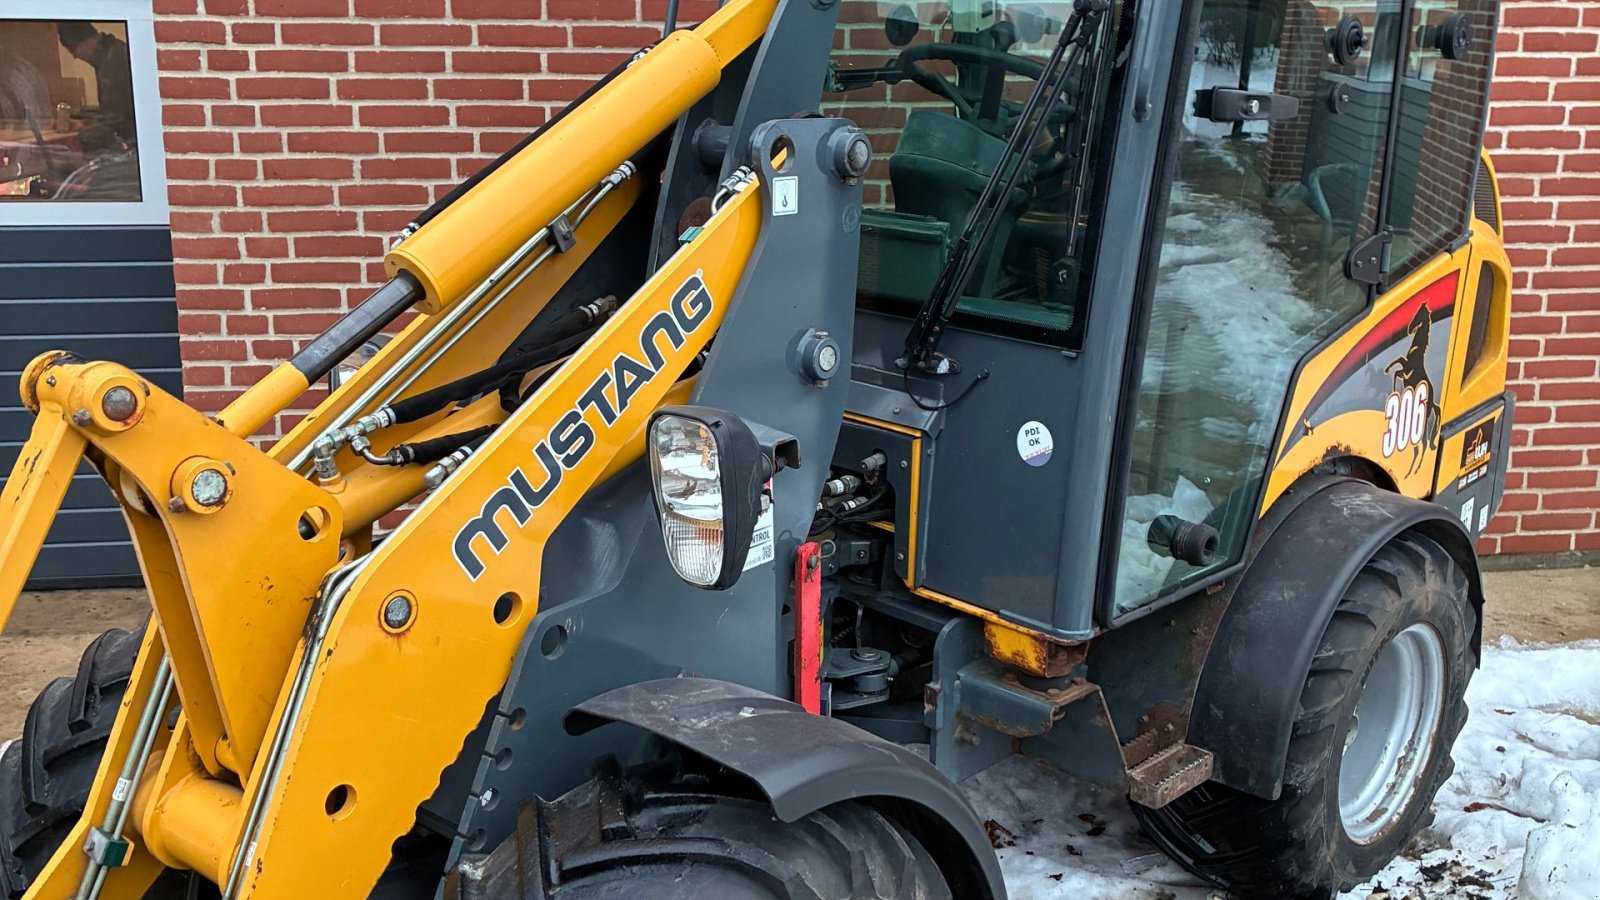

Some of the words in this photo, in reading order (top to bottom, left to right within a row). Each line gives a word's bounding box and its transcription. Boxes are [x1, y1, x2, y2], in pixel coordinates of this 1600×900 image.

[1383, 381, 1427, 458] 306
[452, 273, 713, 582] MUSTANG
[1024, 427, 1040, 437] PDI
[1028, 438, 1041, 447] OK
[752, 530, 770, 543] NTROL
